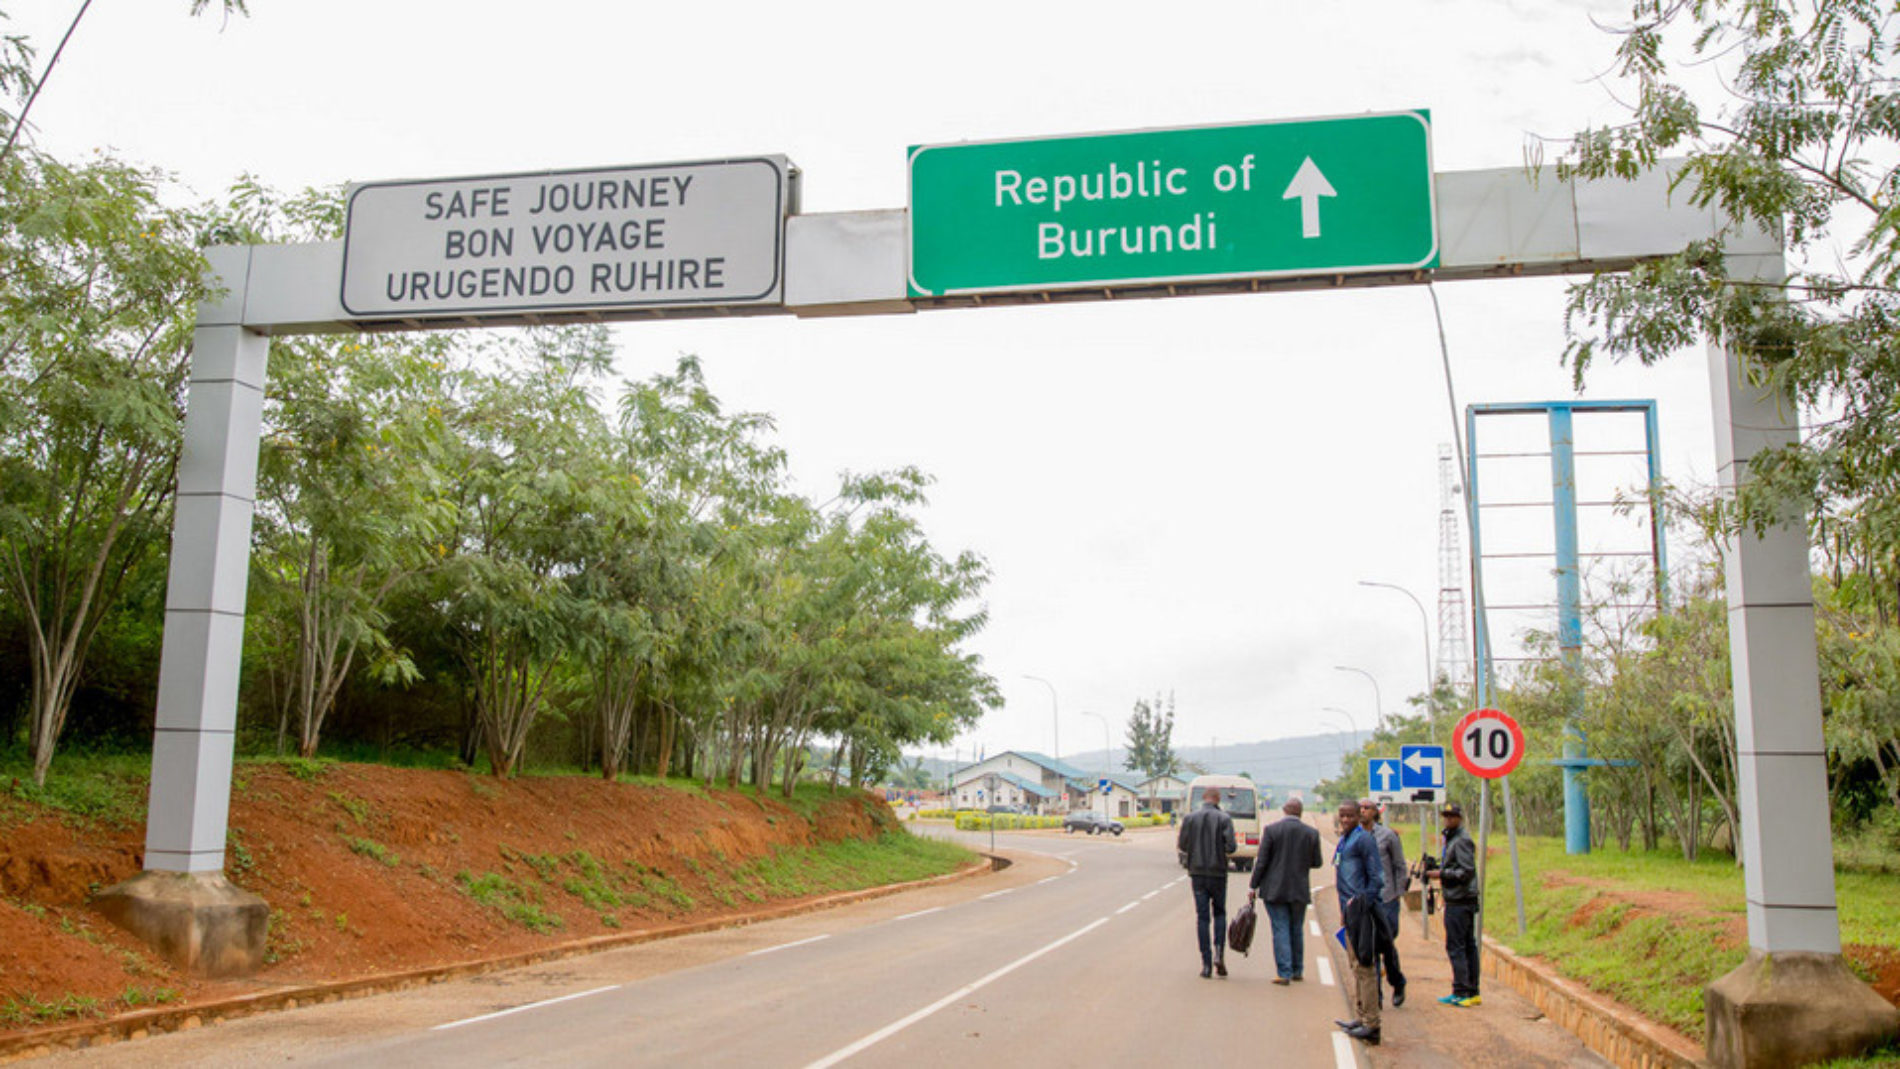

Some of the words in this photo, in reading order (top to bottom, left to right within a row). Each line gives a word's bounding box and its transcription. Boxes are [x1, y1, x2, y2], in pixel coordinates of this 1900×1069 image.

[424, 187, 512, 221] SAFE
[529, 175, 693, 214] JOURNEY
[995, 160, 1187, 212] Republic
[1214, 154, 1255, 192] of
[445, 227, 514, 260] BON
[533, 219, 667, 255] VOYAGE
[1038, 211, 1217, 260] Burundi
[386, 264, 574, 302] URUGENDO
[591, 258, 725, 294] RUHIRE
[1466, 727, 1509, 760] 10
